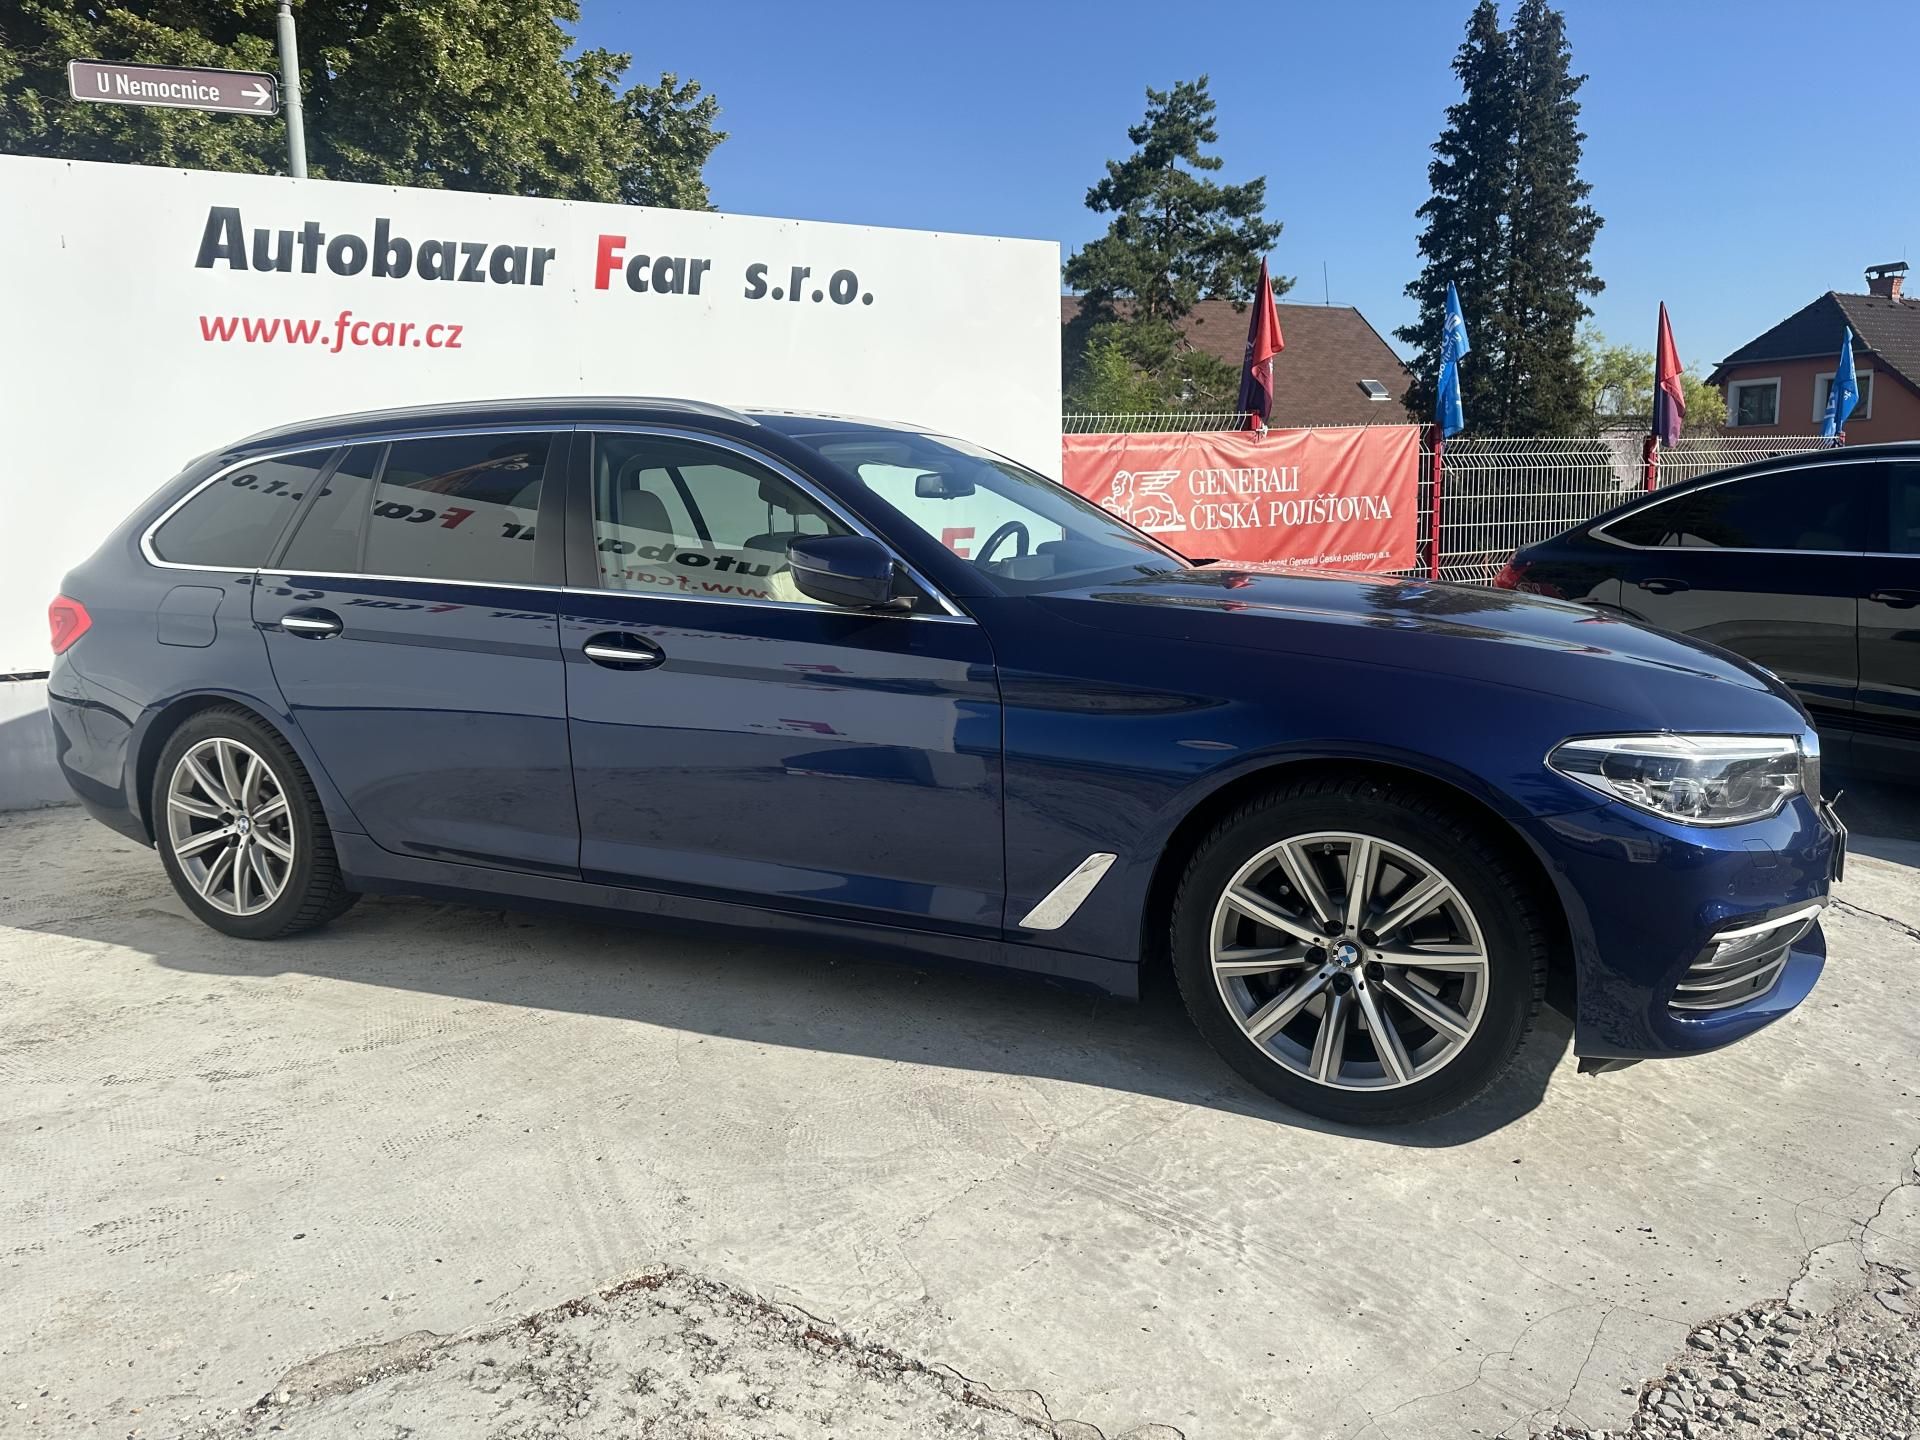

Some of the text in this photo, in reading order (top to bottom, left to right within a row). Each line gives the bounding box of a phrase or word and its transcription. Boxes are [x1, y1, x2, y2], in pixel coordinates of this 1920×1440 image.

[97, 72, 220, 101] U Nemocnice
[195, 206, 874, 306] Autobazar Fcar s.r.o.
[200, 310, 463, 354] www.fcar.cz
[1188, 466, 1300, 496] GENERALI
[1190, 492, 1393, 531] ČESKÁ POJIŠŤOVNA
[1320, 552, 1342, 564] České
